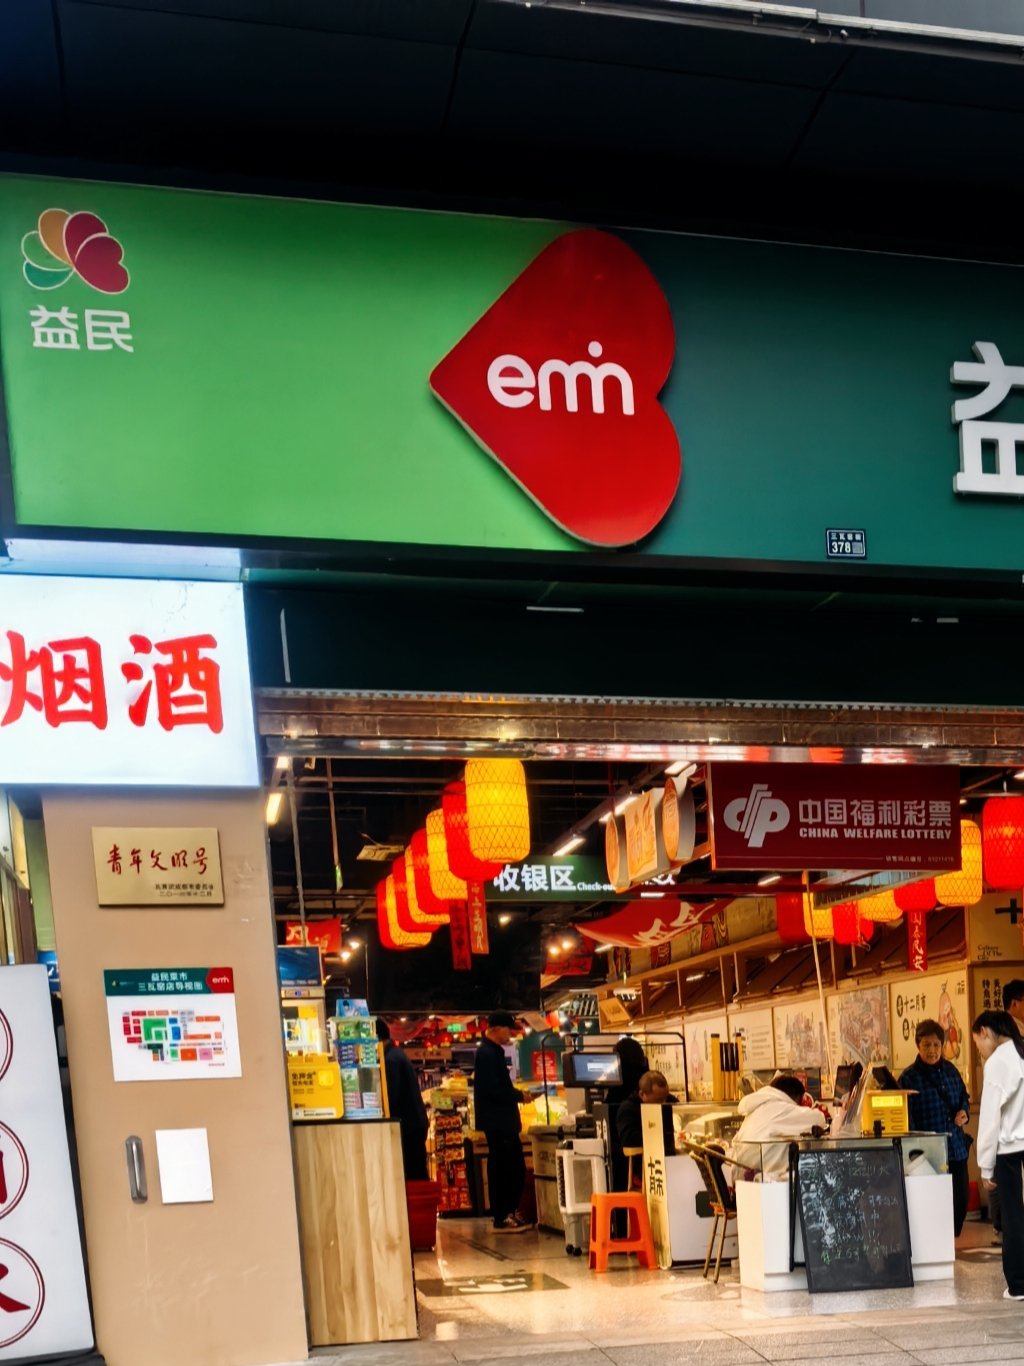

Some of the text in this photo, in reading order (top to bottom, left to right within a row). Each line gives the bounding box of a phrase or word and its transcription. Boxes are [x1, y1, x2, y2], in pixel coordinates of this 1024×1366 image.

[30, 305, 134, 353] 益民
[832, 541, 851, 553] 378
[0, 630, 224, 734] 烟酒
[799, 799, 952, 827] 中国福利彩票
[800, 827, 952, 840] CHINA WELFARE LOTTERY
[107, 844, 207, 875] 青年文明号
[494, 863, 616, 892] 收银区 Check-ou
